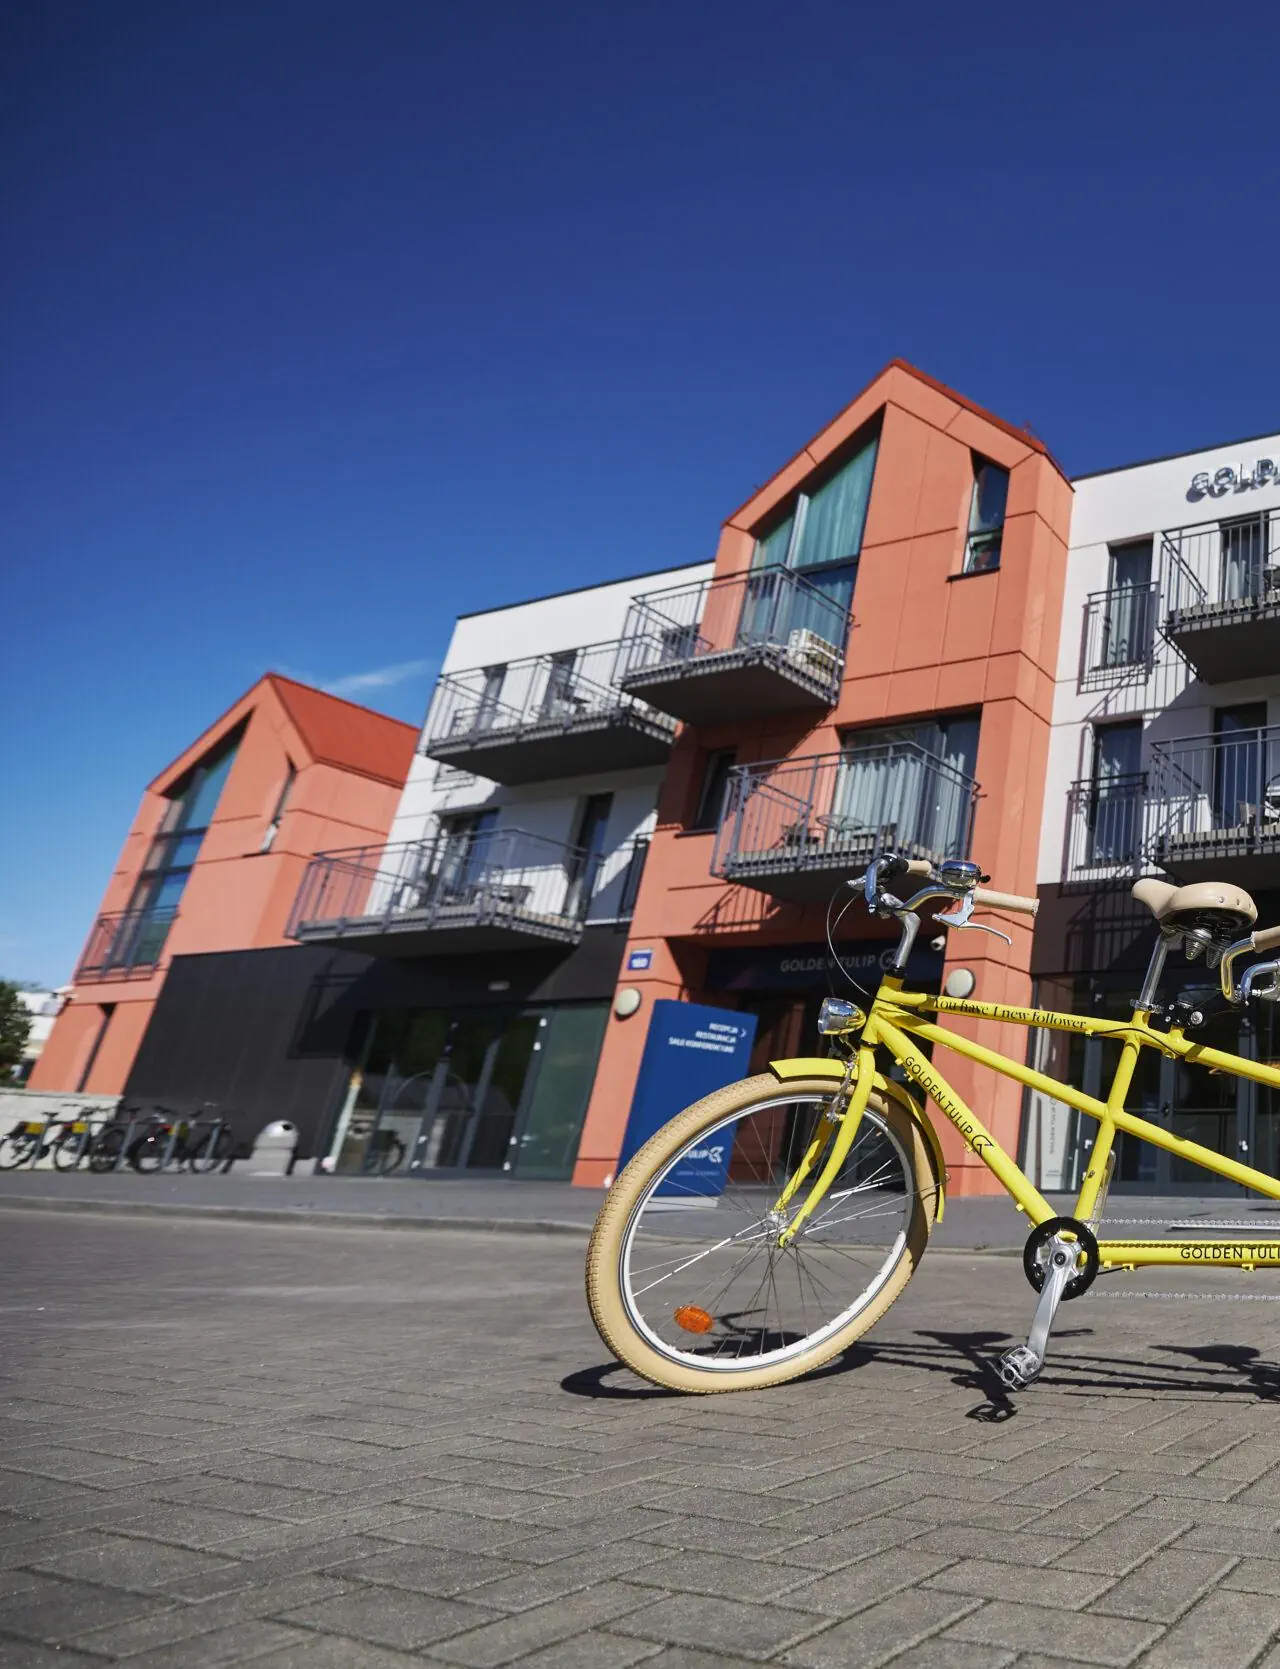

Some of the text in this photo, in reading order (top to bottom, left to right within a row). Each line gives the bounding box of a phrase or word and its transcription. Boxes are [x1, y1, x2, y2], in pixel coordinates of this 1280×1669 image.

[838, 954, 877, 969] TULIP
[934, 998, 957, 1011] You
[960, 1000, 989, 1016] have
[1002, 1009, 1030, 1020] new
[1031, 1011, 1087, 1029] follower
[905, 1056, 973, 1134] GOLDEN TULIP
[1180, 1246, 1243, 1259] GOLDEN
